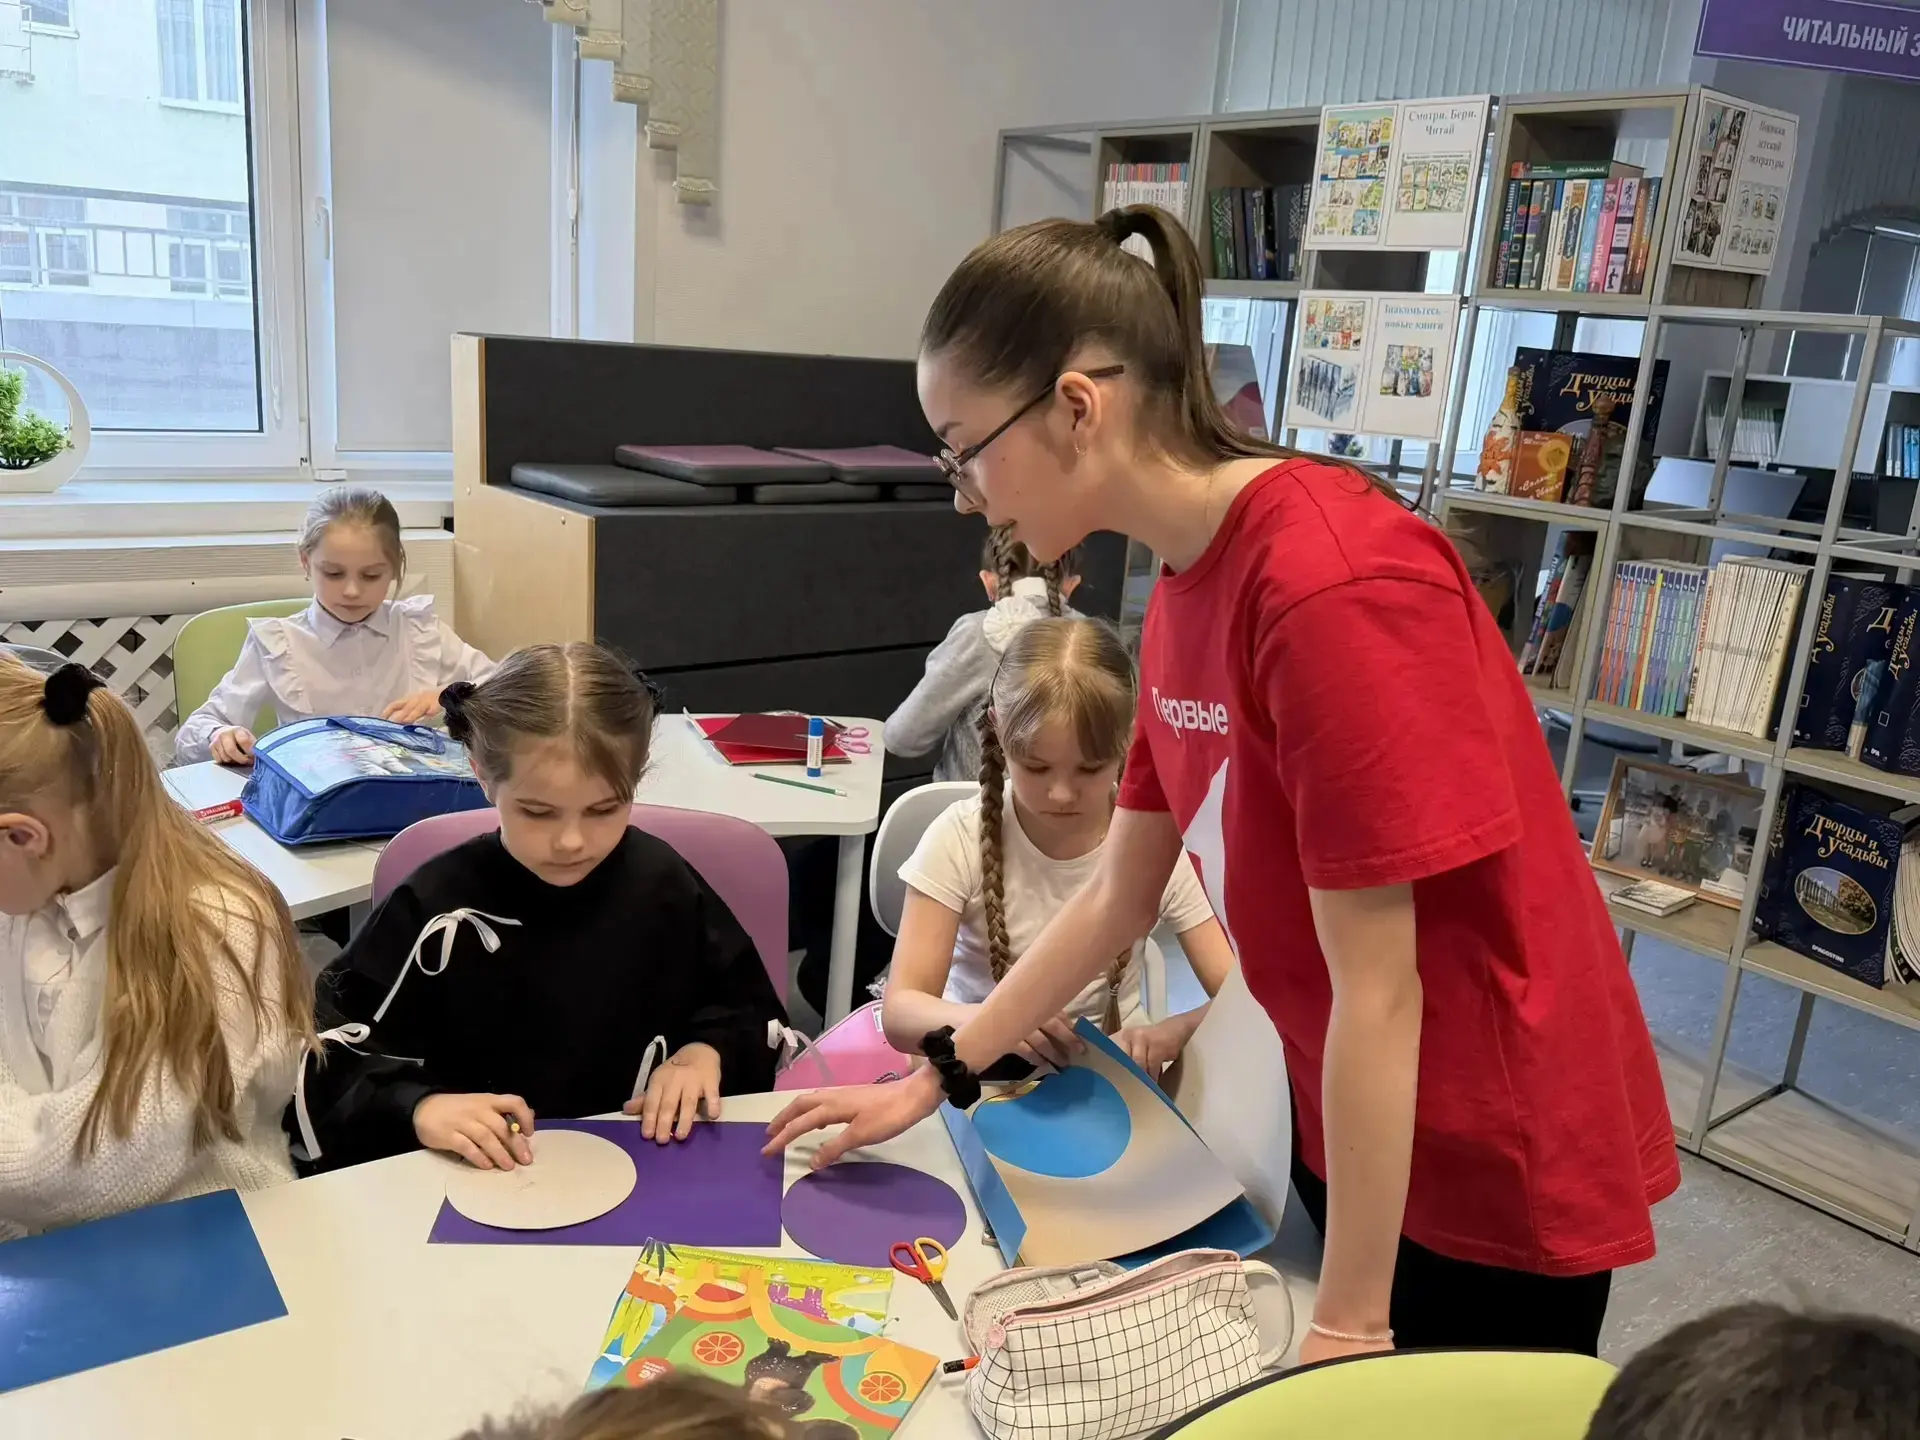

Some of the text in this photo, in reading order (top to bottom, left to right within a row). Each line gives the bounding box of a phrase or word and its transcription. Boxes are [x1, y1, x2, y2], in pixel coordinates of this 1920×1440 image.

[1782, 15, 1909, 56] ЧИТАЛЬНЫЙ
[1559, 372, 1632, 398] Дворцы
[1575, 389, 1655, 412] Уадь
[1815, 593, 1836, 652] Усадьбы
[1899, 608, 1918, 669] Усадьбы
[1888, 625, 1906, 680] Дворцы
[1151, 686, 1229, 739] Первые
[1804, 813, 1878, 850] Дворцы и
[1817, 835, 1889, 871] Усадьбы
